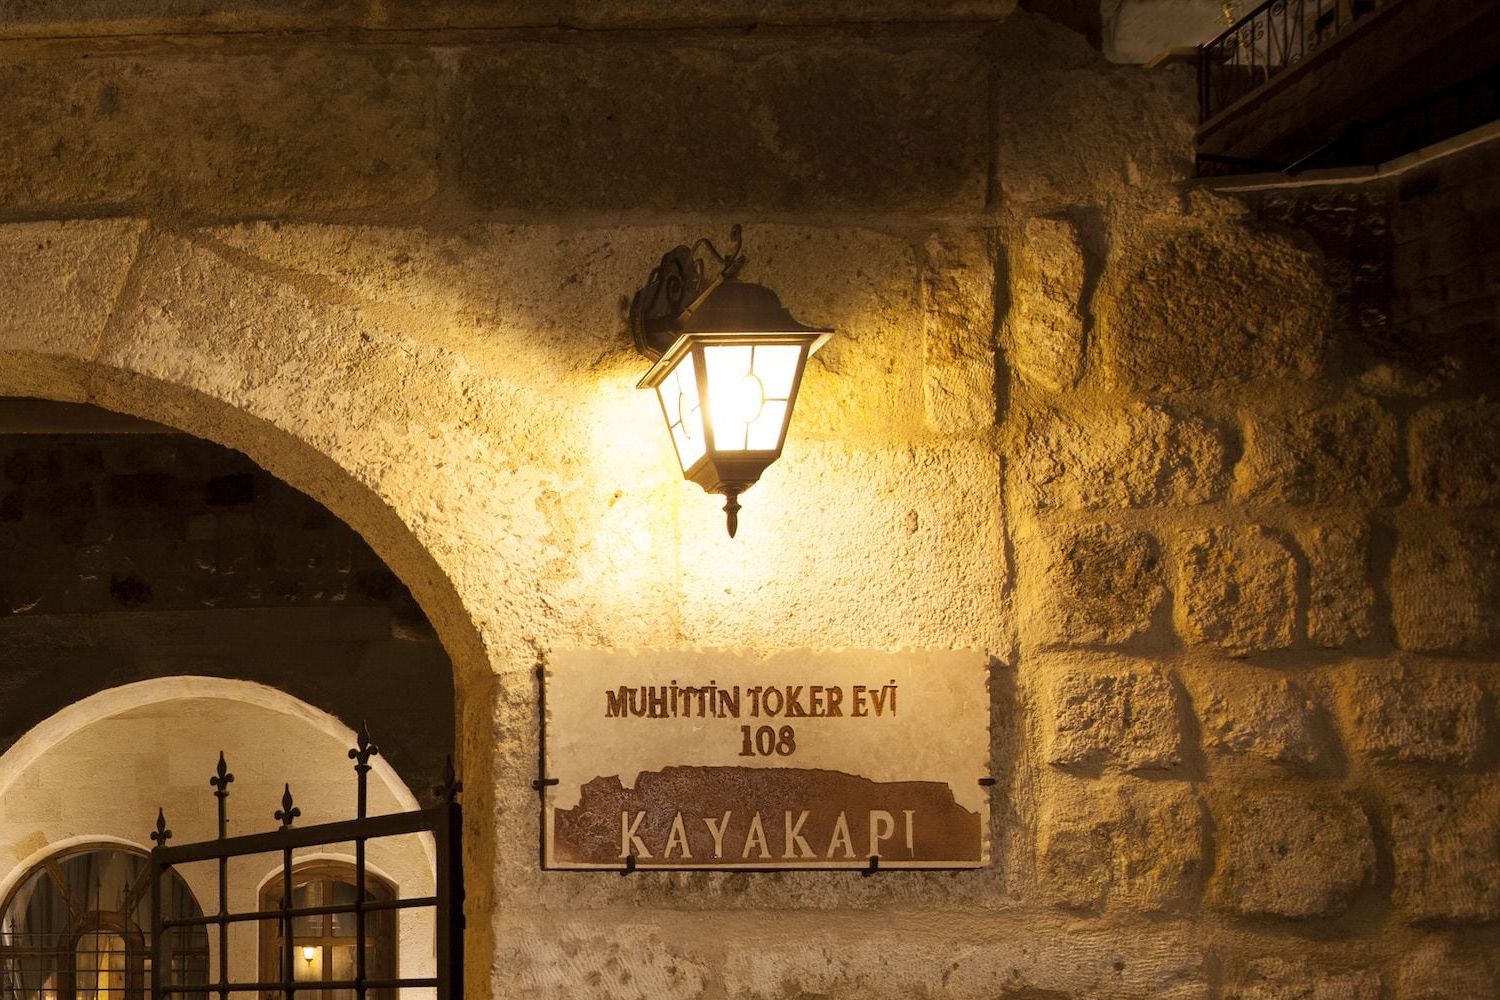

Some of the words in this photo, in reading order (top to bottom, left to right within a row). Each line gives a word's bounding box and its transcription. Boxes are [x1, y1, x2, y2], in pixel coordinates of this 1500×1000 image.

[605, 680, 740, 718] MUHİTTİN
[747, 686, 843, 718] TOKER
[851, 679, 898, 717] EVİ
[738, 725, 797, 757] 108
[617, 809, 917, 859] KAYAKAPI
